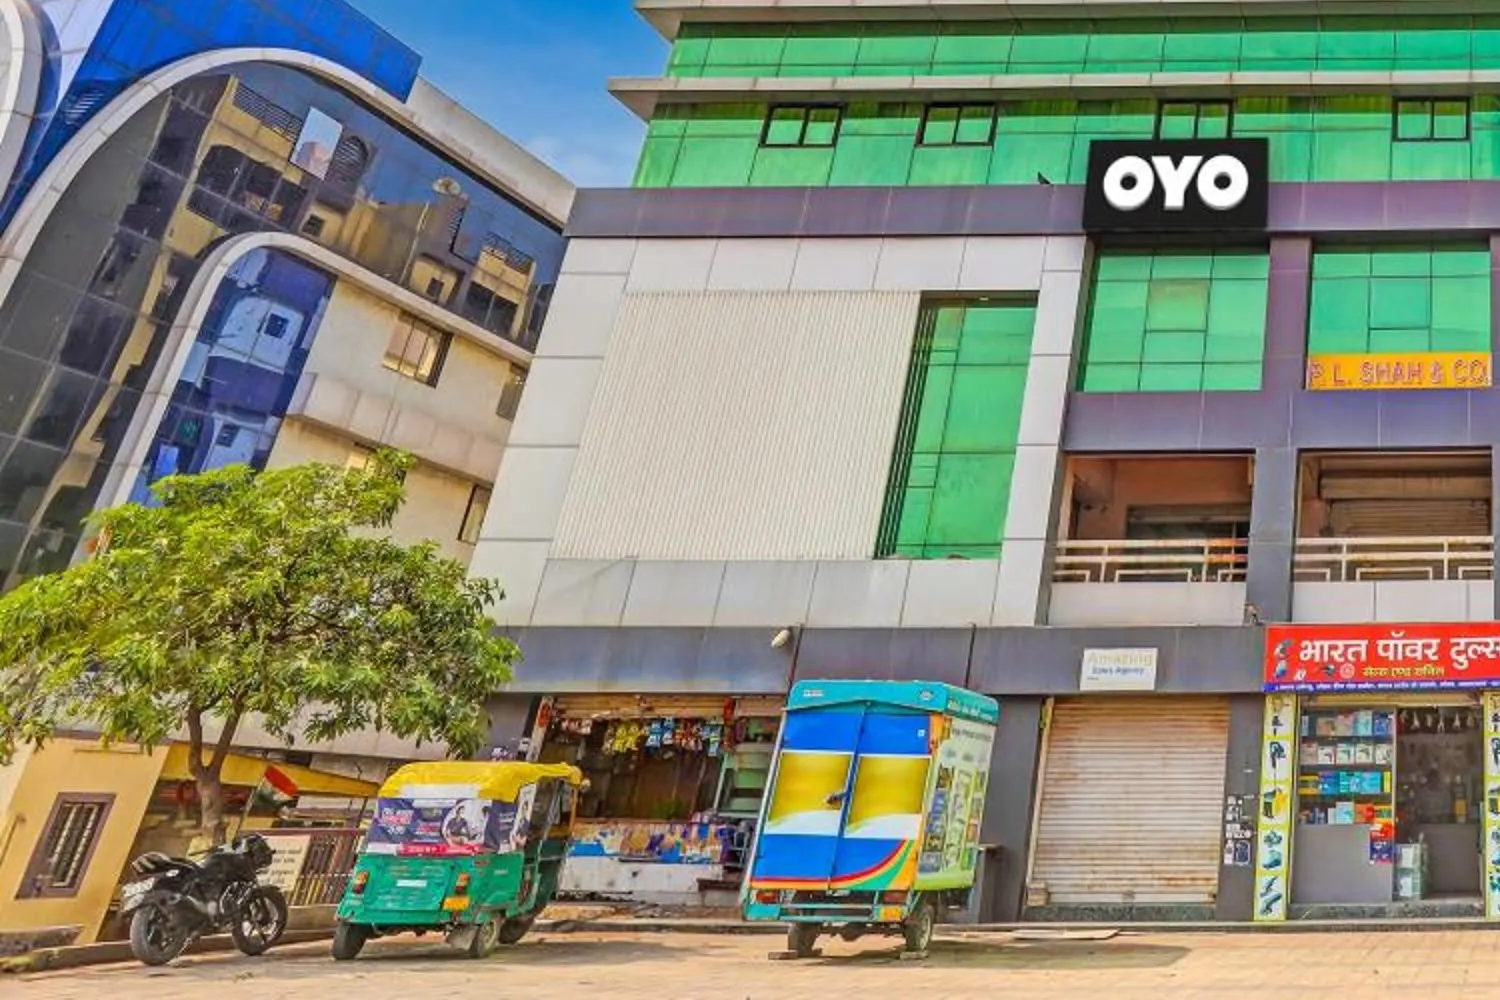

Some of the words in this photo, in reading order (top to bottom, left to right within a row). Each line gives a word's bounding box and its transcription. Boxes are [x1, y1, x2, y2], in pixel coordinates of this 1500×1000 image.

[1103, 154, 1249, 211] OYO
[1360, 360, 1424, 385] SHAH
[1430, 360, 1444, 385] &
[1299, 639, 1368, 662] भारत
[1376, 631, 1440, 661] पॉवर
